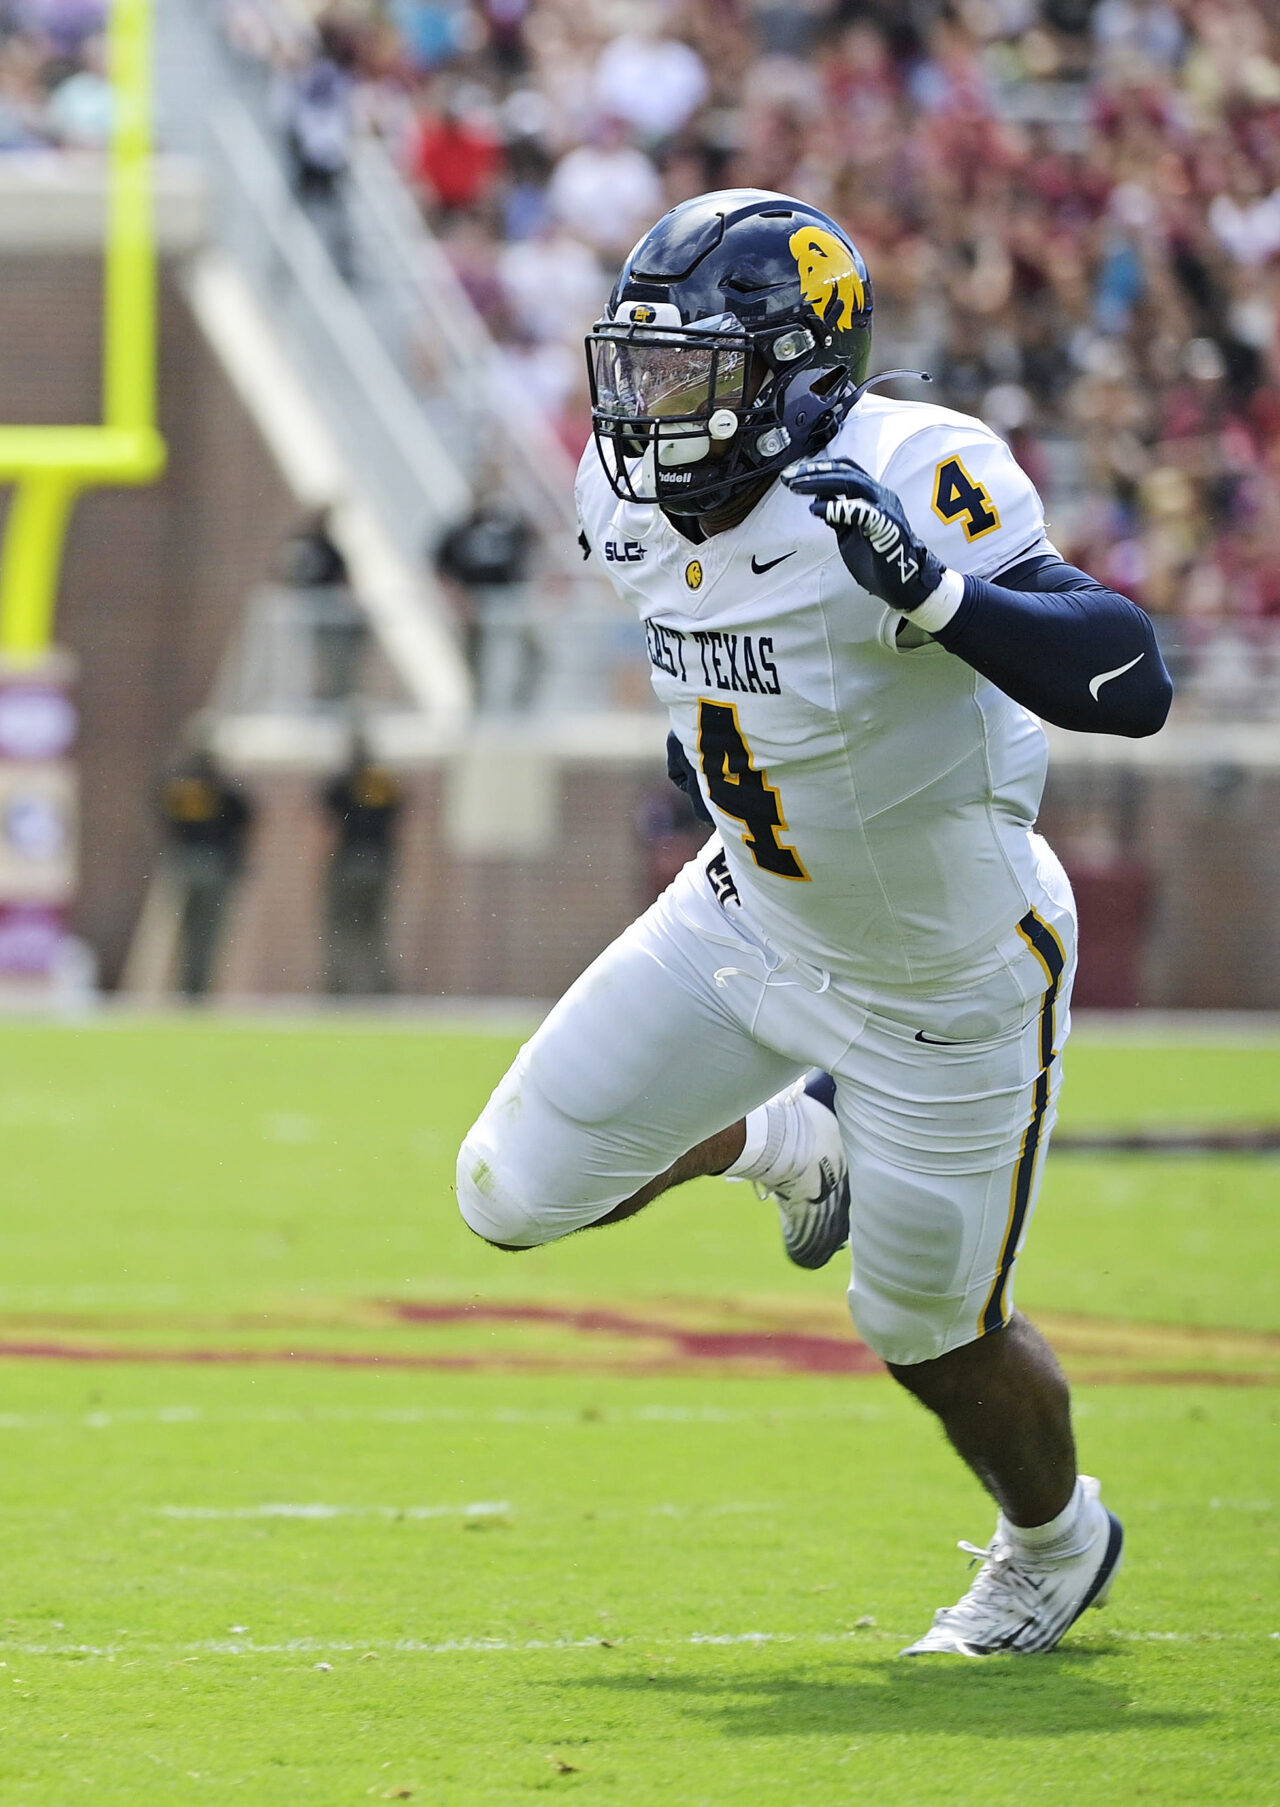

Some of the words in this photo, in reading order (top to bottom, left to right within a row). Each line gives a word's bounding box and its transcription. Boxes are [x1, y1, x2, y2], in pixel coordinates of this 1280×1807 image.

[658, 471, 692, 483] iddell
[931, 455, 1002, 544] 4
[605, 541, 642, 562] SLC
[691, 631, 782, 696] TEXAS
[698, 698, 812, 882] 4
